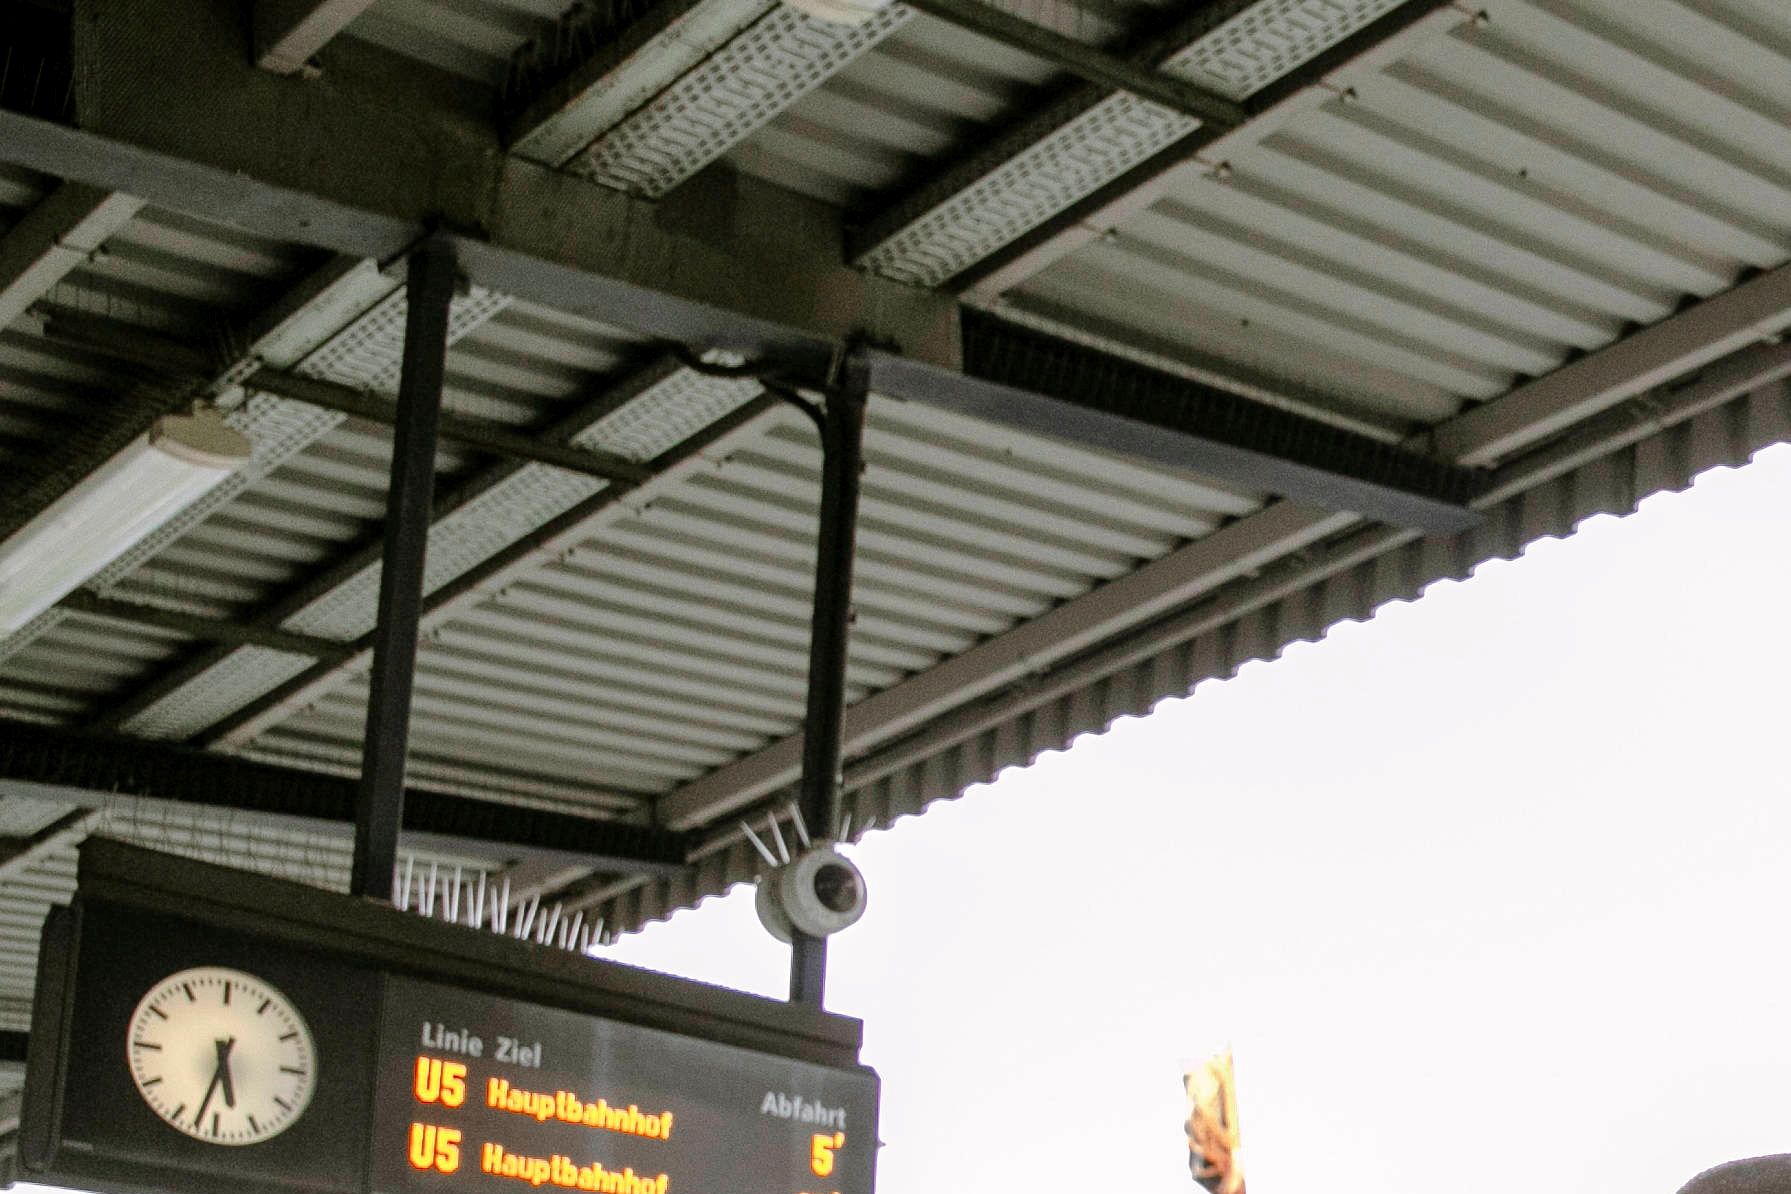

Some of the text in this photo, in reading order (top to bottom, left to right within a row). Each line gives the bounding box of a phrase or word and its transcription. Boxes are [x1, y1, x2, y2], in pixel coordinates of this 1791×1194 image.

[420, 1022, 541, 1067] Linie Ziel
[414, 1057, 674, 1140] U5 Hauptbahnhof
[760, 1091, 847, 1129] Abfahrt
[408, 1122, 462, 1173] U5
